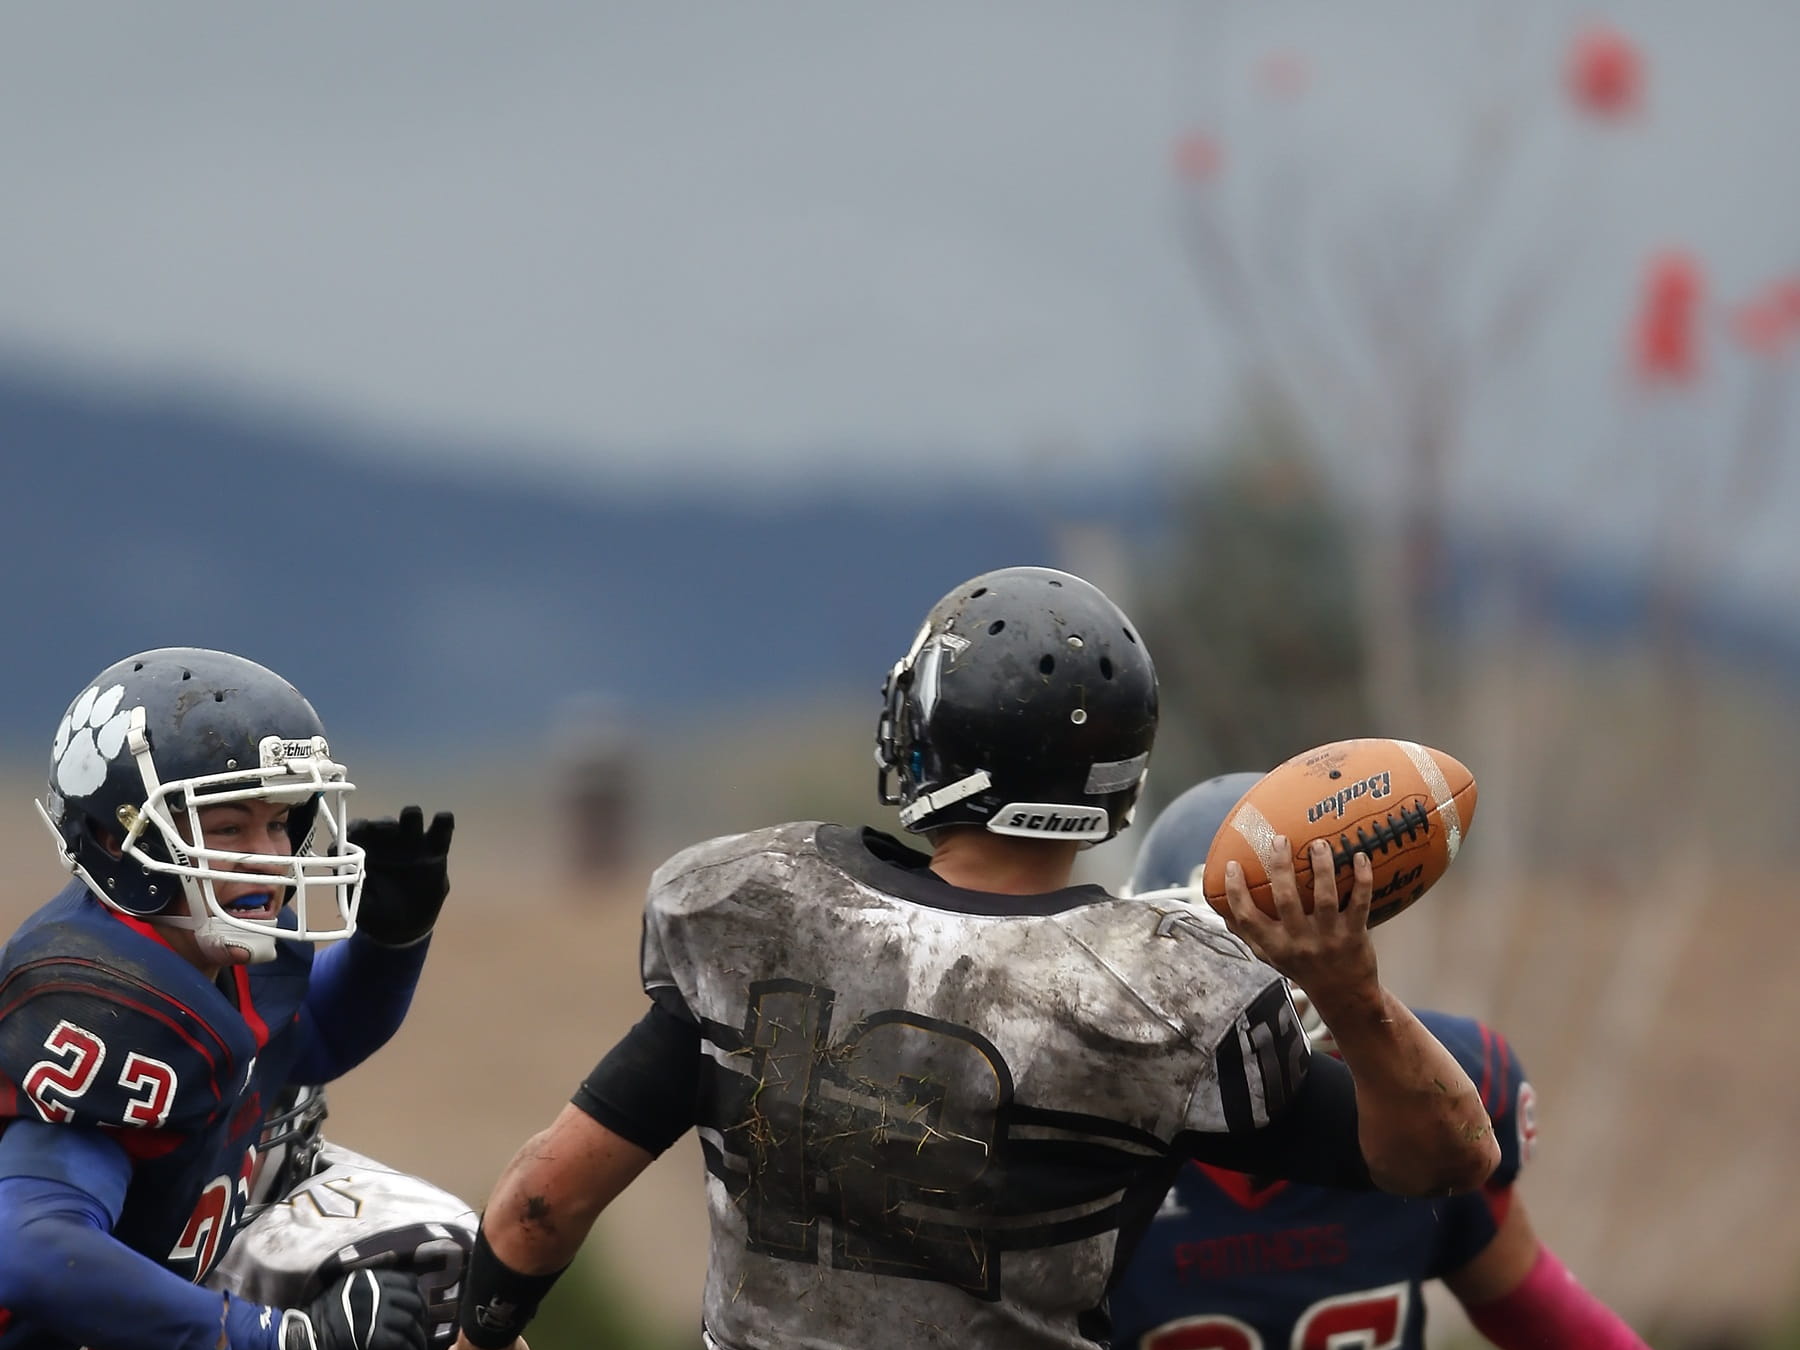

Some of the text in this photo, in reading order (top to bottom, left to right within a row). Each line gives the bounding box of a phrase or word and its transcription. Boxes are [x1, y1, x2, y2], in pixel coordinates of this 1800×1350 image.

[1009, 812, 1102, 832] schutt
[22, 1019, 178, 1128] 23
[746, 977, 1014, 1301] 12
